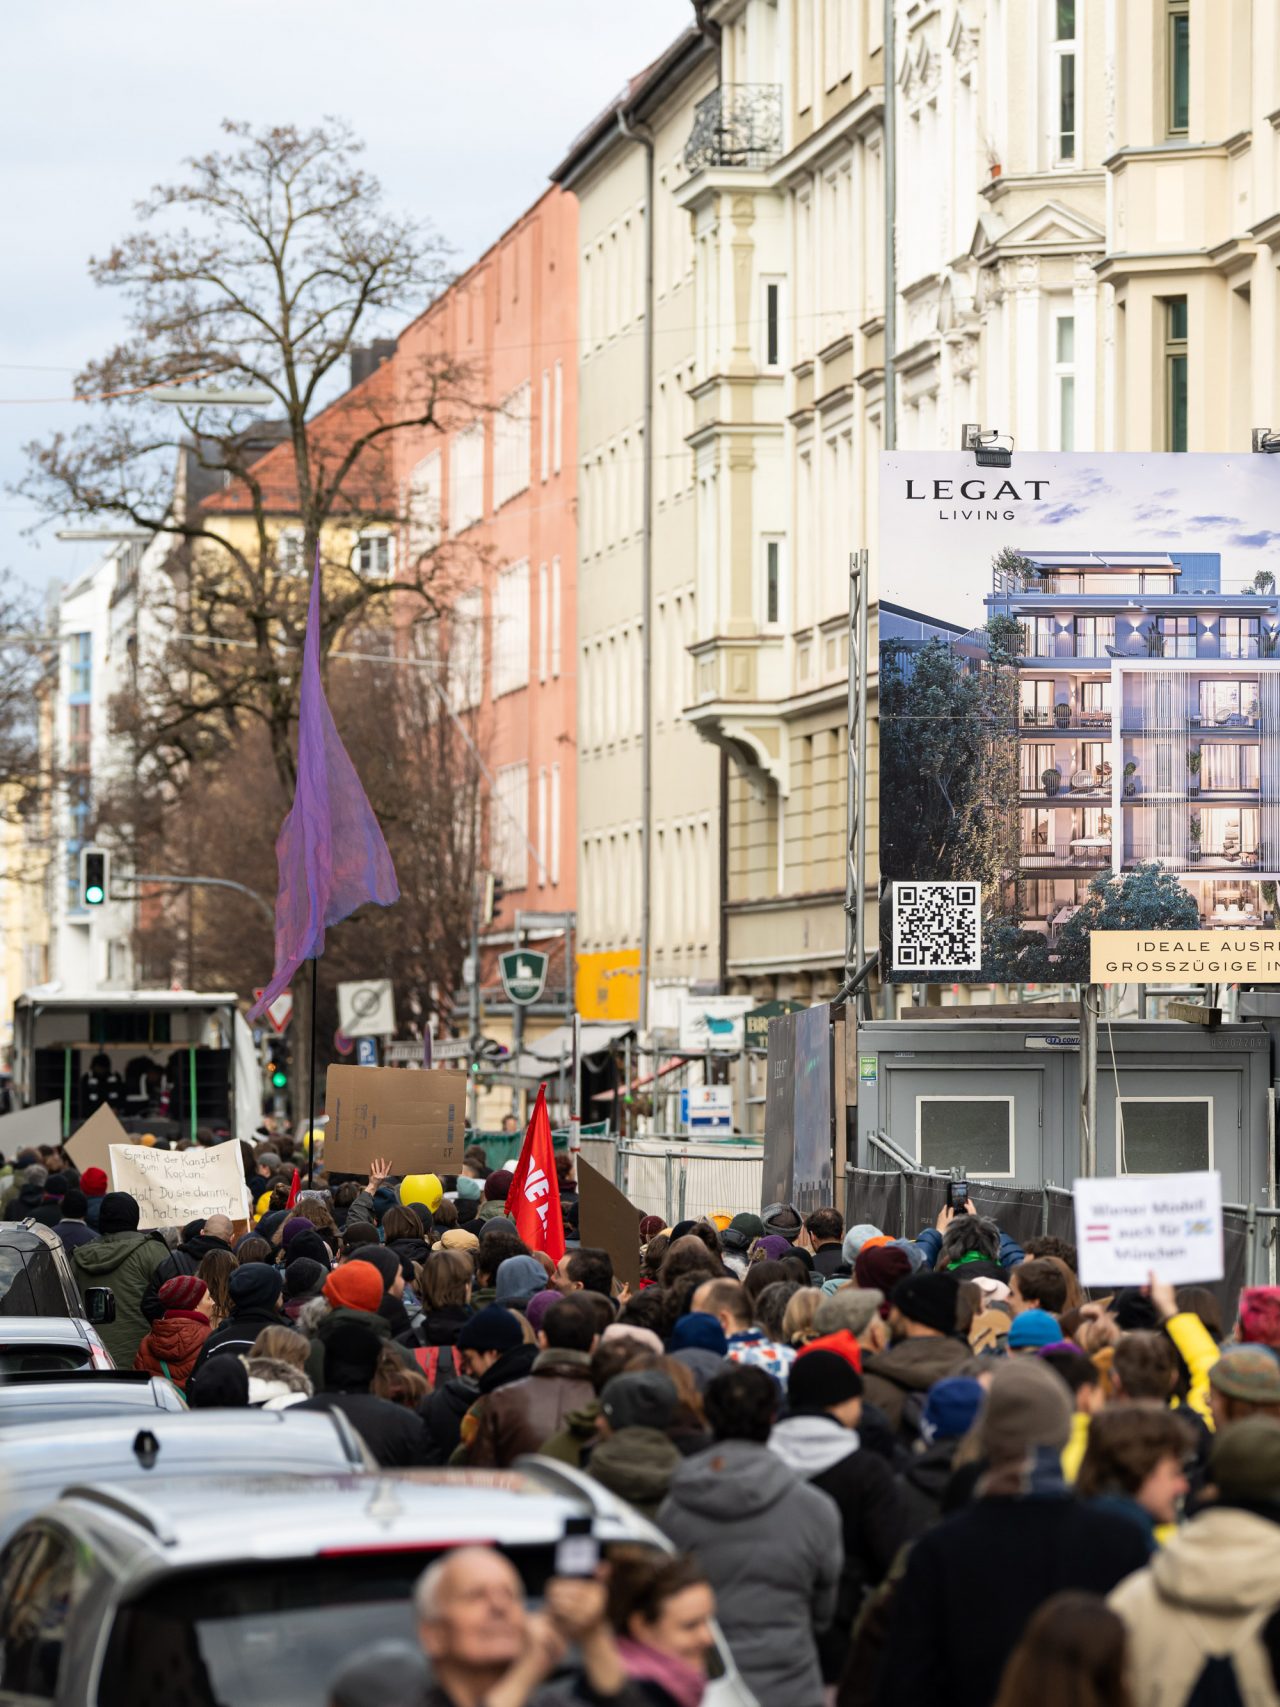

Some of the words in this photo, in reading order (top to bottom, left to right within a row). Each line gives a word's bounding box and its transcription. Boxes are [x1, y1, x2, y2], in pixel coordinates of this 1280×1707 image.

[905, 480, 1050, 500] LEGAT
[939, 510, 1015, 520] LIVING
[1136, 942, 1210, 952] IDEALE
[1106, 959, 1257, 972] GROSSZÜGIGE
[123, 1148, 160, 1166] Spricht
[164, 1153, 178, 1164] der
[140, 1164, 159, 1175] zum
[130, 1186, 153, 1202] Halt
[159, 1186, 174, 1199] Du
[176, 1188, 191, 1197] sie
[151, 1203, 178, 1219] halt
[183, 1208, 199, 1218] sie
